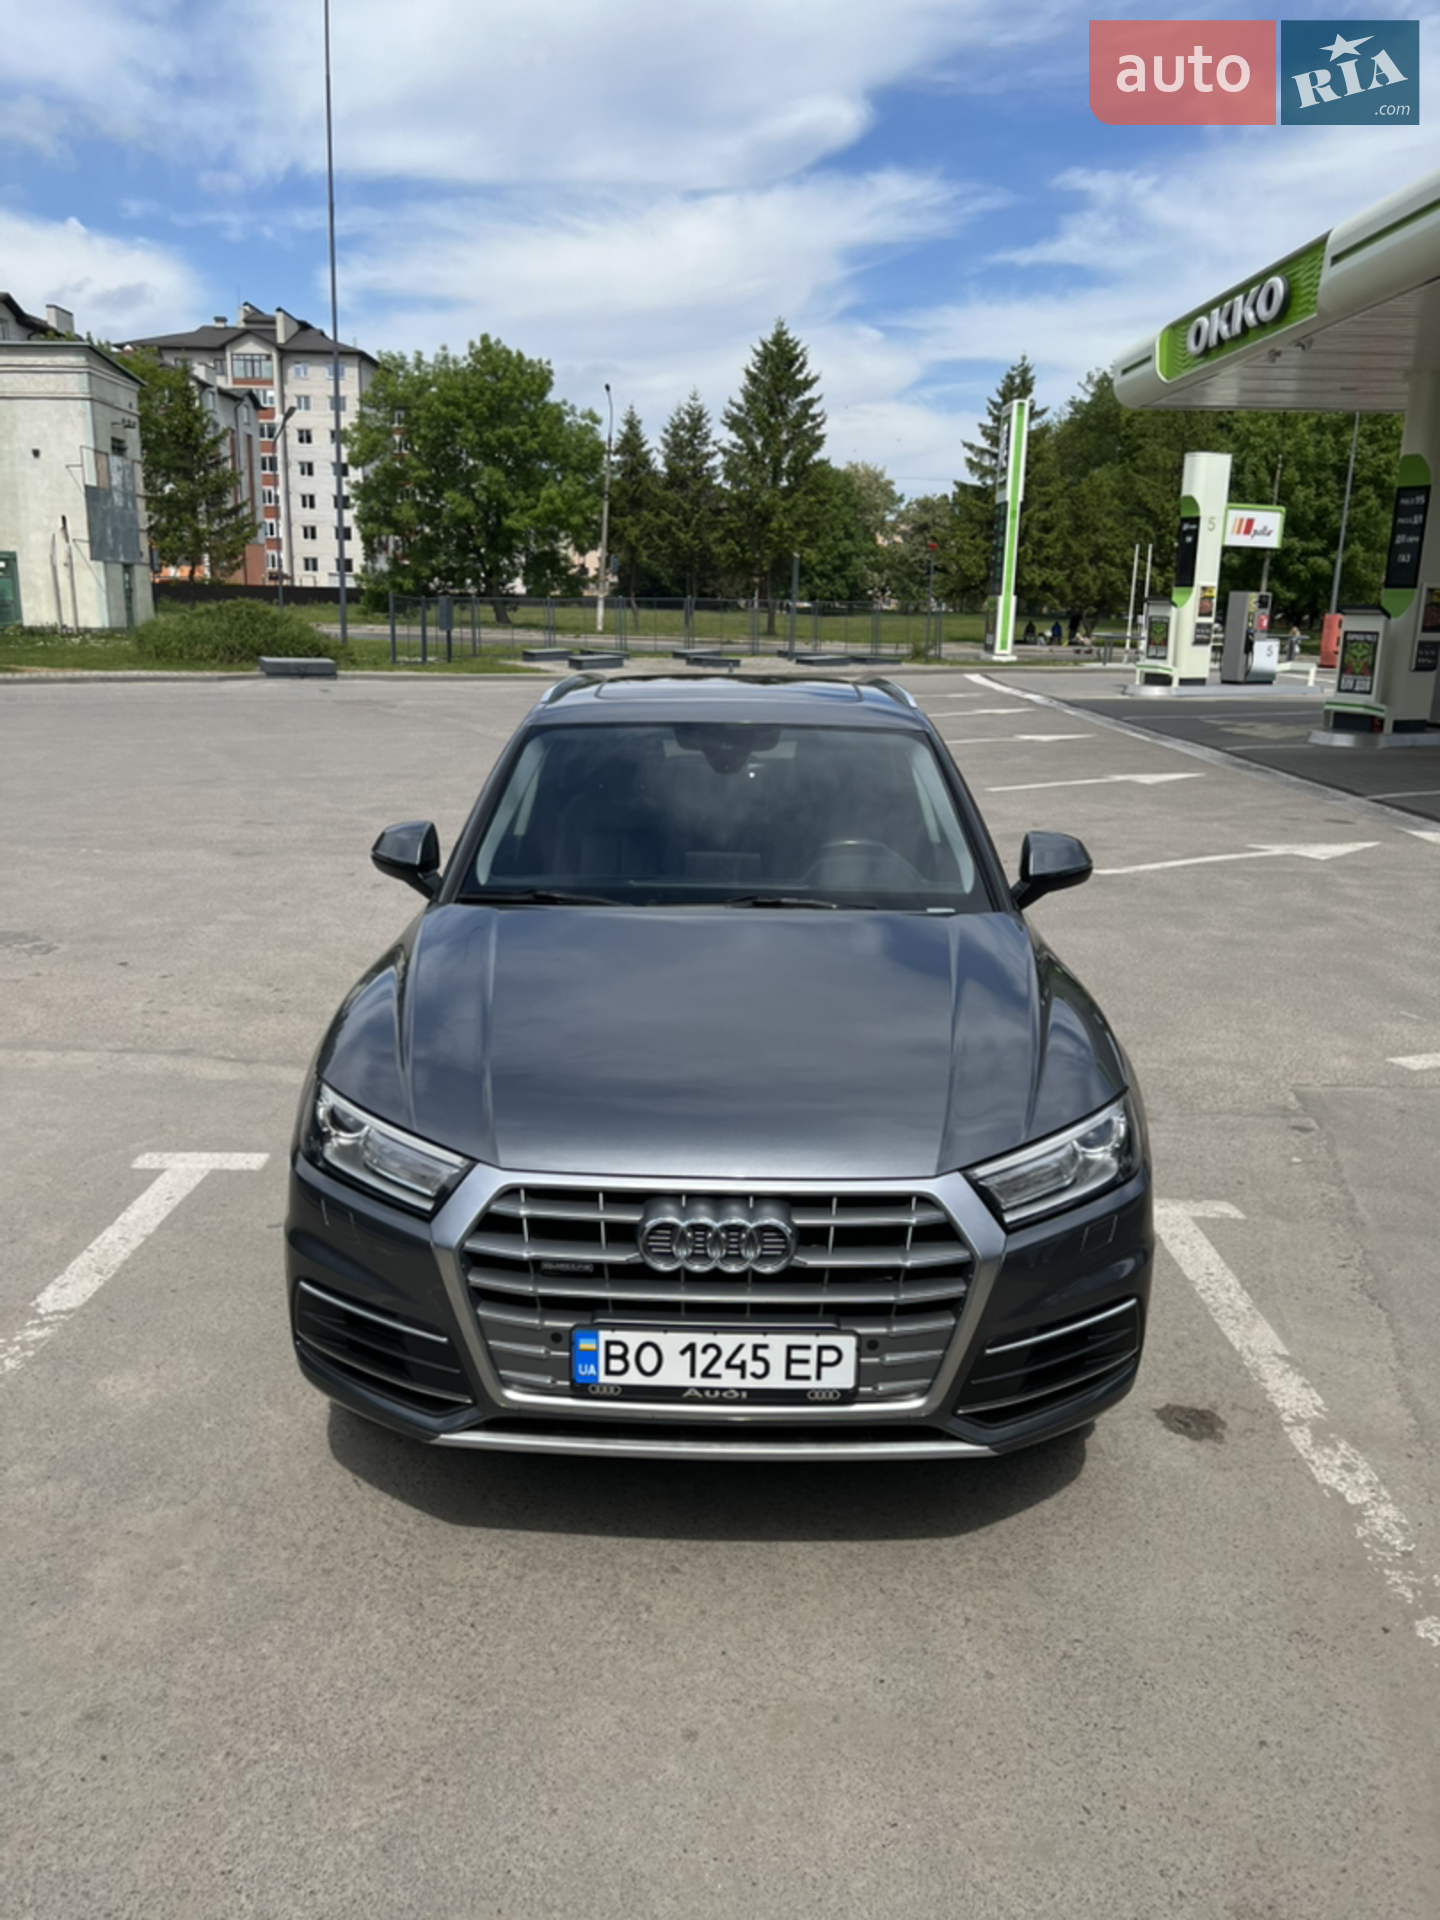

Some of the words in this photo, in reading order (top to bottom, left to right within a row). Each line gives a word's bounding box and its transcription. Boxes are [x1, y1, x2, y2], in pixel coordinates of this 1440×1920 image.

[1187, 273, 1290, 357] OKKO
[1206, 516, 1217, 532] 5
[579, 1363, 598, 1376] UA
[603, 1339, 664, 1378] BO
[679, 1341, 771, 1380] 1245
[784, 1343, 844, 1381] EP
